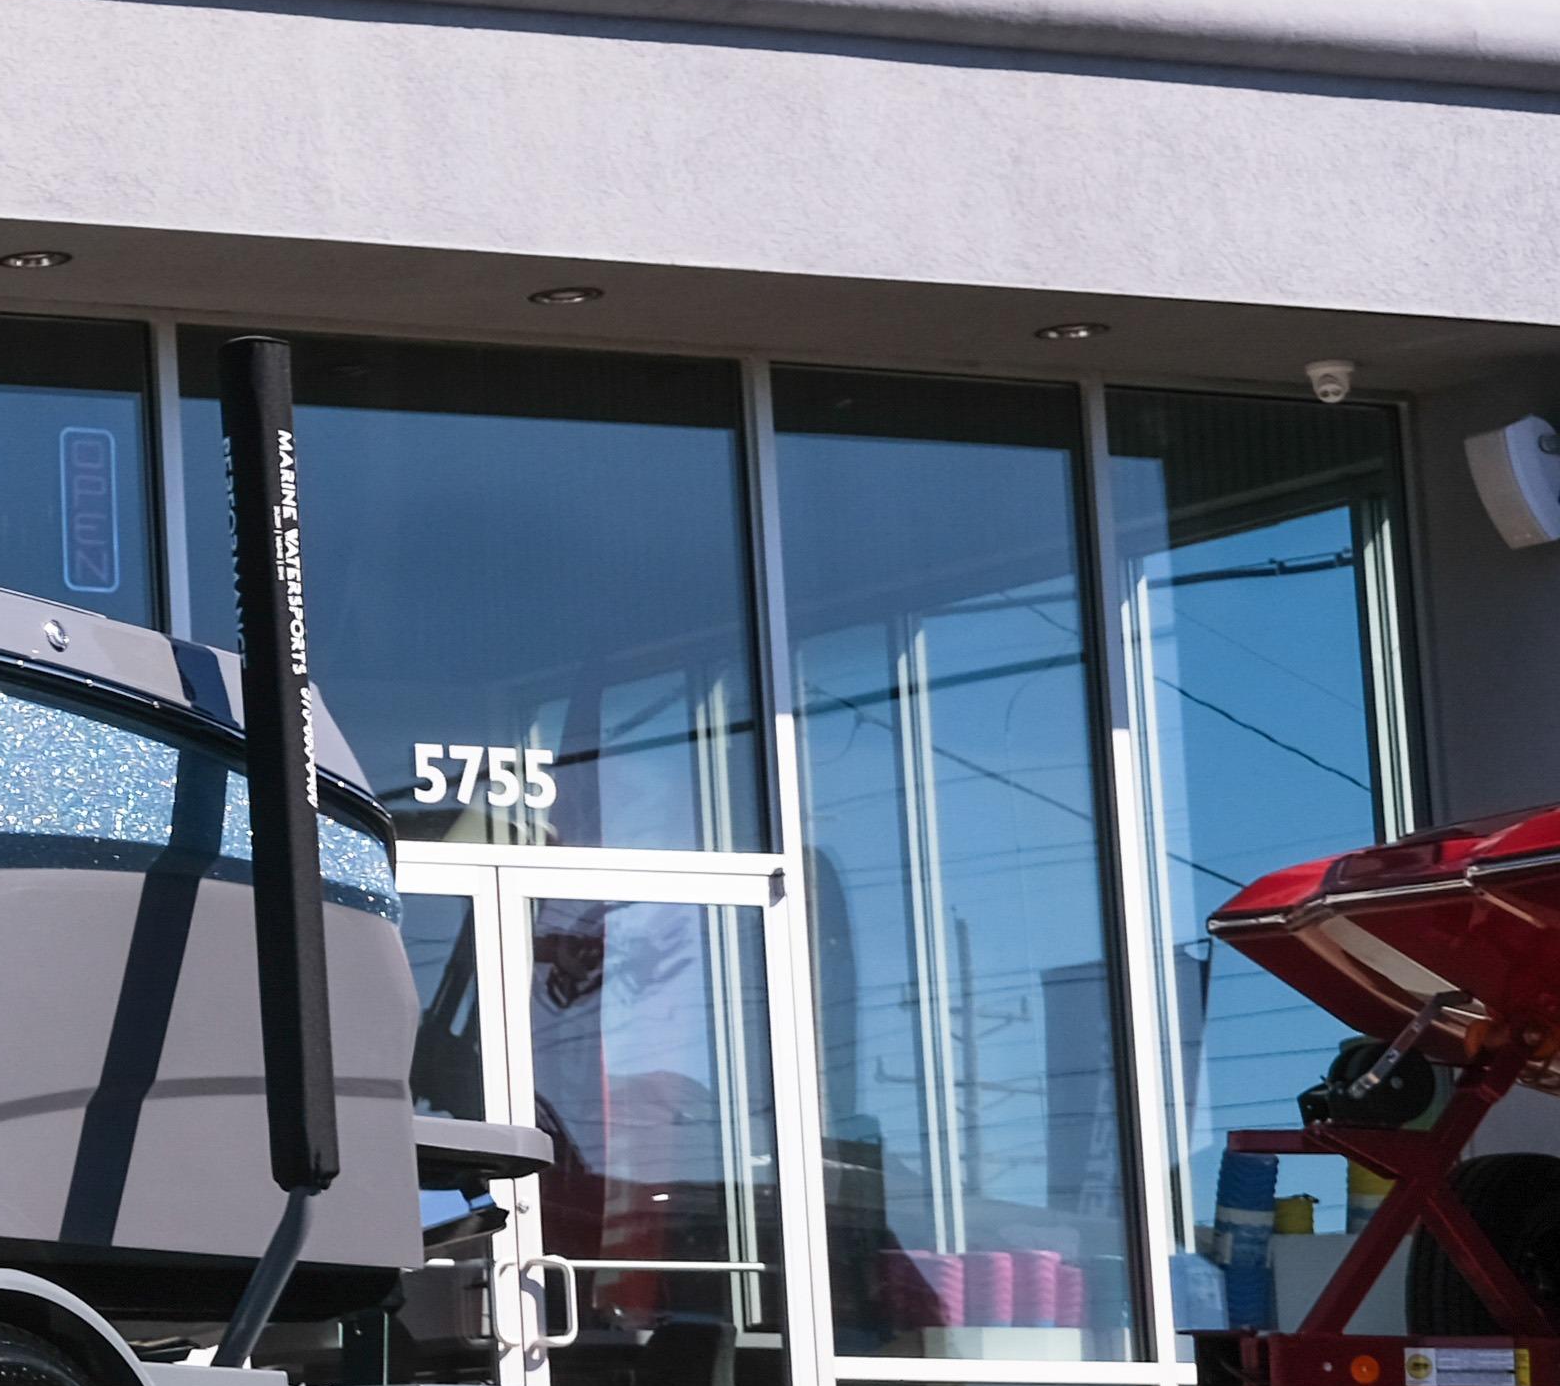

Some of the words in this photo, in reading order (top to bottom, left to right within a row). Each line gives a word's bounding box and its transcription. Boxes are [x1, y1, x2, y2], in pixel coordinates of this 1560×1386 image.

[277, 429, 298, 521] MARINE
[284, 528, 308, 675] WATERSPORTS
[413, 742, 557, 809] 5755
